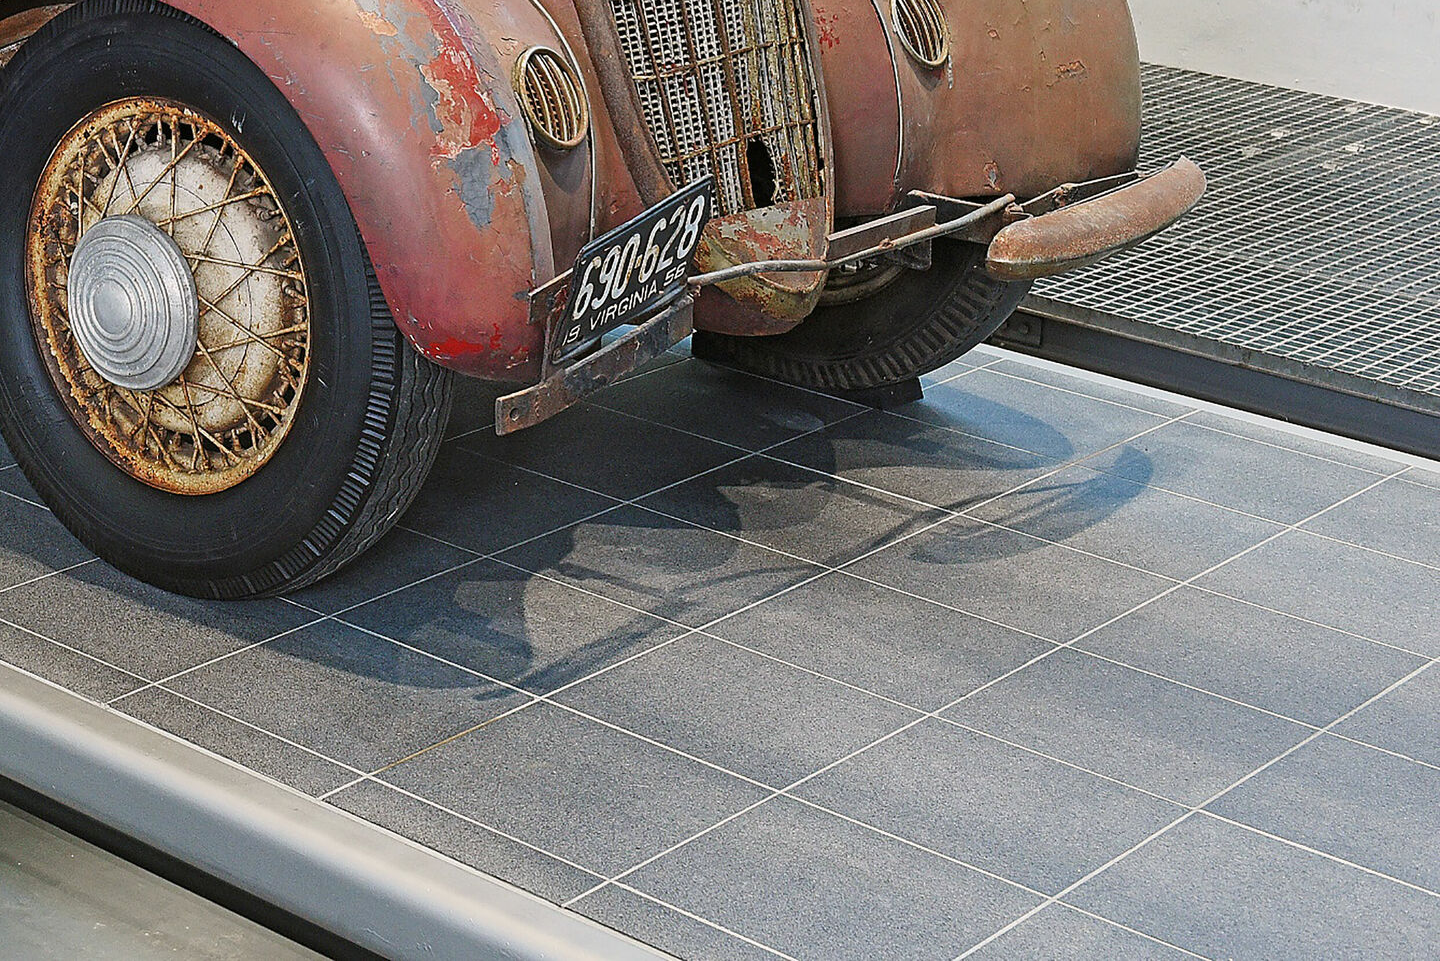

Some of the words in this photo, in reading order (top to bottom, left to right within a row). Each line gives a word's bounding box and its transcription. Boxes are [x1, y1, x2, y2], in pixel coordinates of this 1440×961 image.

[562, 324, 581, 346] 19
[589, 279, 658, 330] VIRGINIA
[664, 261, 687, 286] 56
